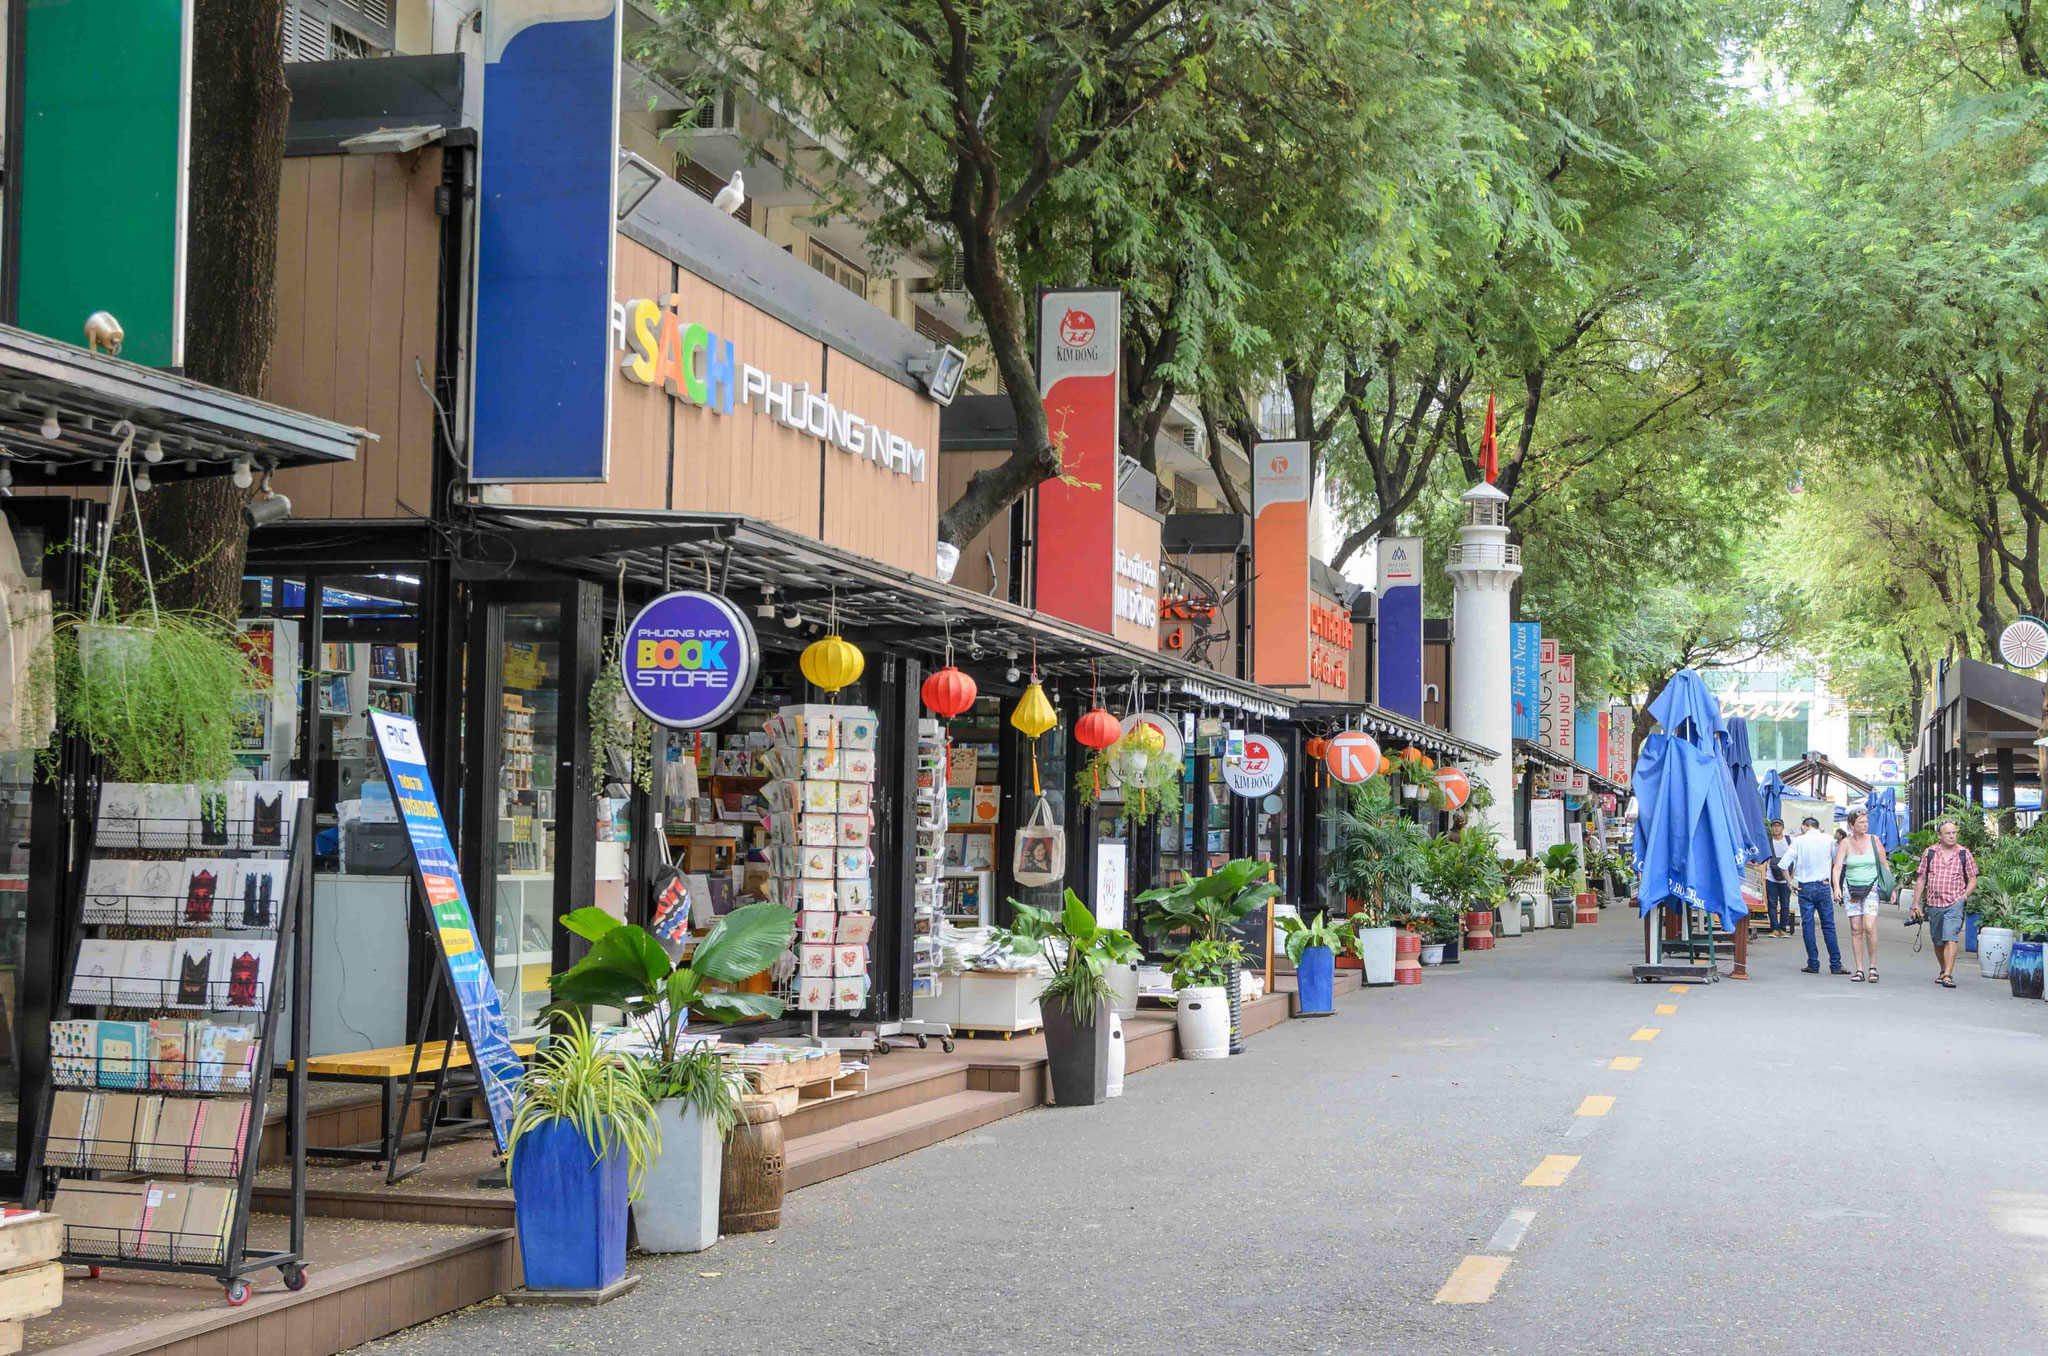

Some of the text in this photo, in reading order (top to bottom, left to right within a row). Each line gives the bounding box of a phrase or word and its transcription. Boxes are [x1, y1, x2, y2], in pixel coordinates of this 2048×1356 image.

[1056, 345, 1073, 361] KIM
[622, 292, 735, 416] SÁCH
[868, 425, 925, 483] NAM
[698, 629, 729, 638] NAM
[636, 639, 728, 670] BOOK
[1513, 626, 1527, 698] First News
[636, 670, 728, 687] STORE
[386, 724, 411, 746] PNC
[1234, 774, 1250, 788] KIM
